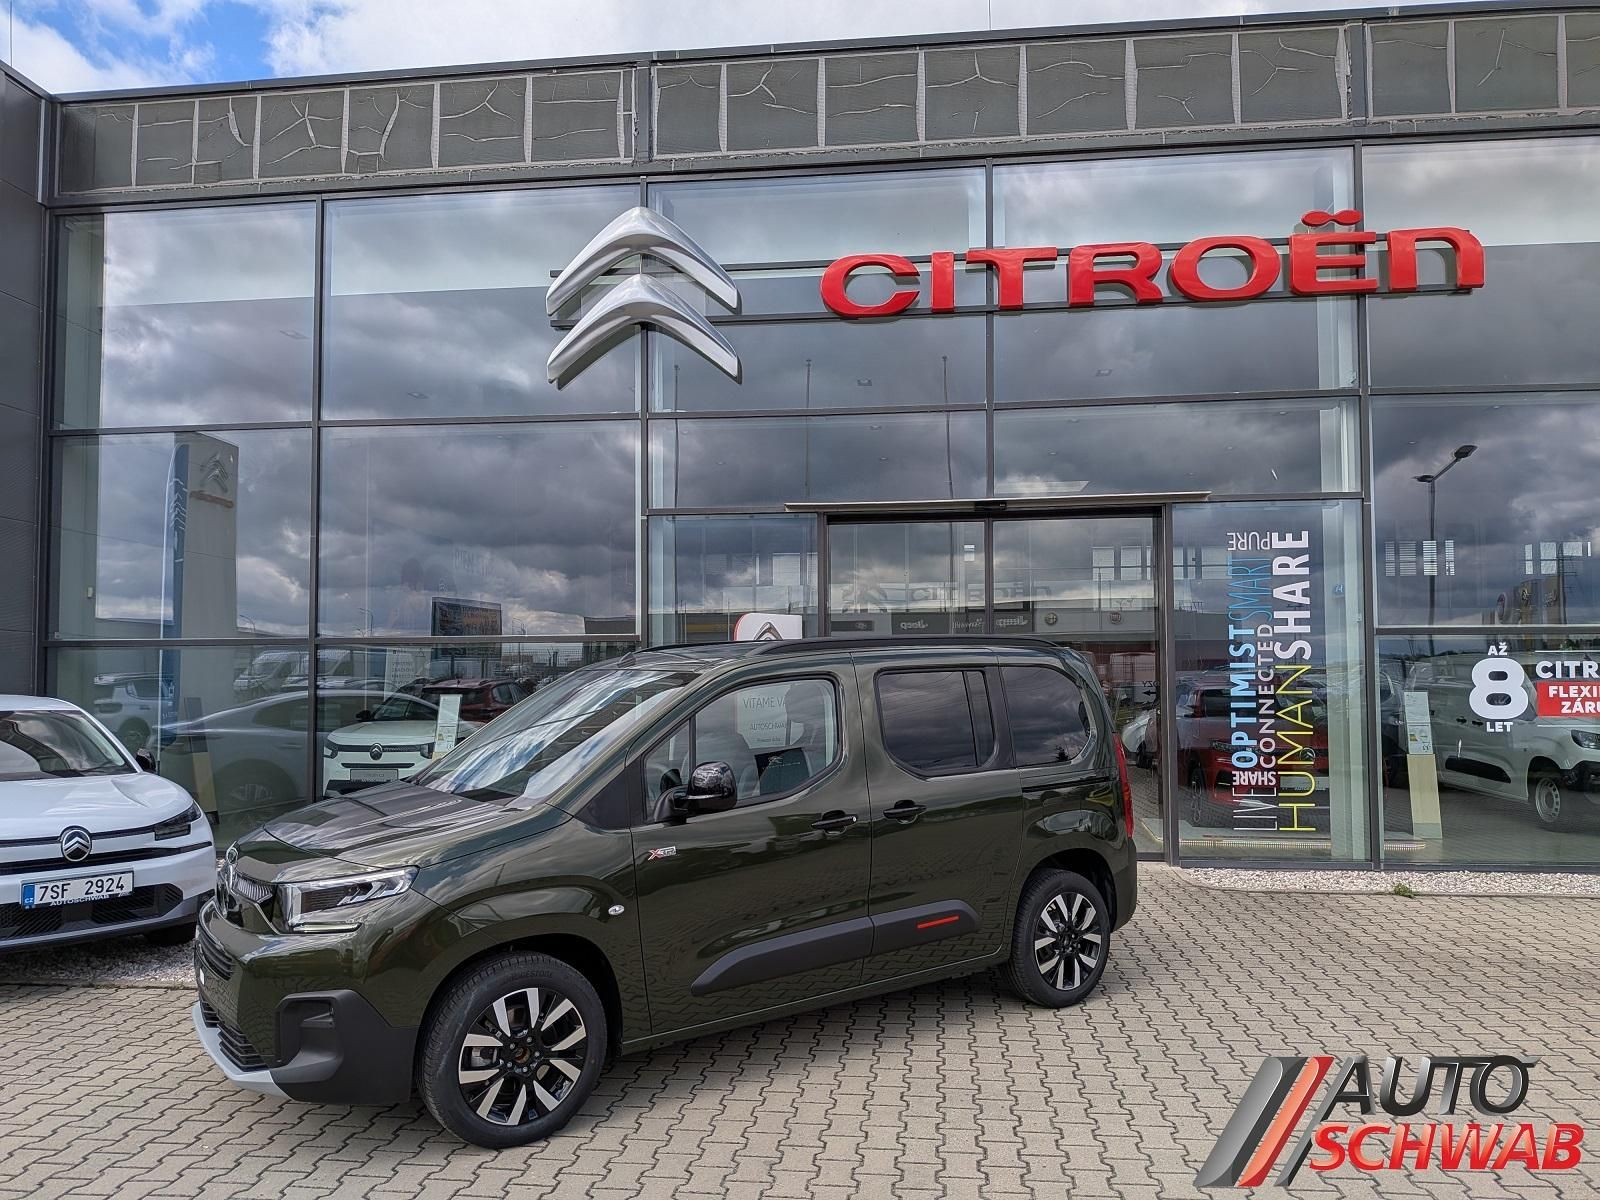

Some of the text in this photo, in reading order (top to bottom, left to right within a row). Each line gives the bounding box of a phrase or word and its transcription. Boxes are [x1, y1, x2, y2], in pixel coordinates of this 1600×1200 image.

[1227, 532, 1271, 551] PURE
[1272, 530, 1312, 660] SHARE
[1228, 552, 1273, 768] OPTIMIST SMART
[1488, 642, 1508, 656] AŽ
[1256, 624, 1277, 769] CONNECTED
[1469, 657, 1529, 720] 8
[1548, 685, 1600, 698] FLEXI
[1486, 721, 1514, 733] LET
[1275, 665, 1316, 831] HUMAN
[1232, 771, 1277, 785] SHARE
[1232, 787, 1278, 831] LIVE
[39, 876, 125, 902] 7SF 2924
